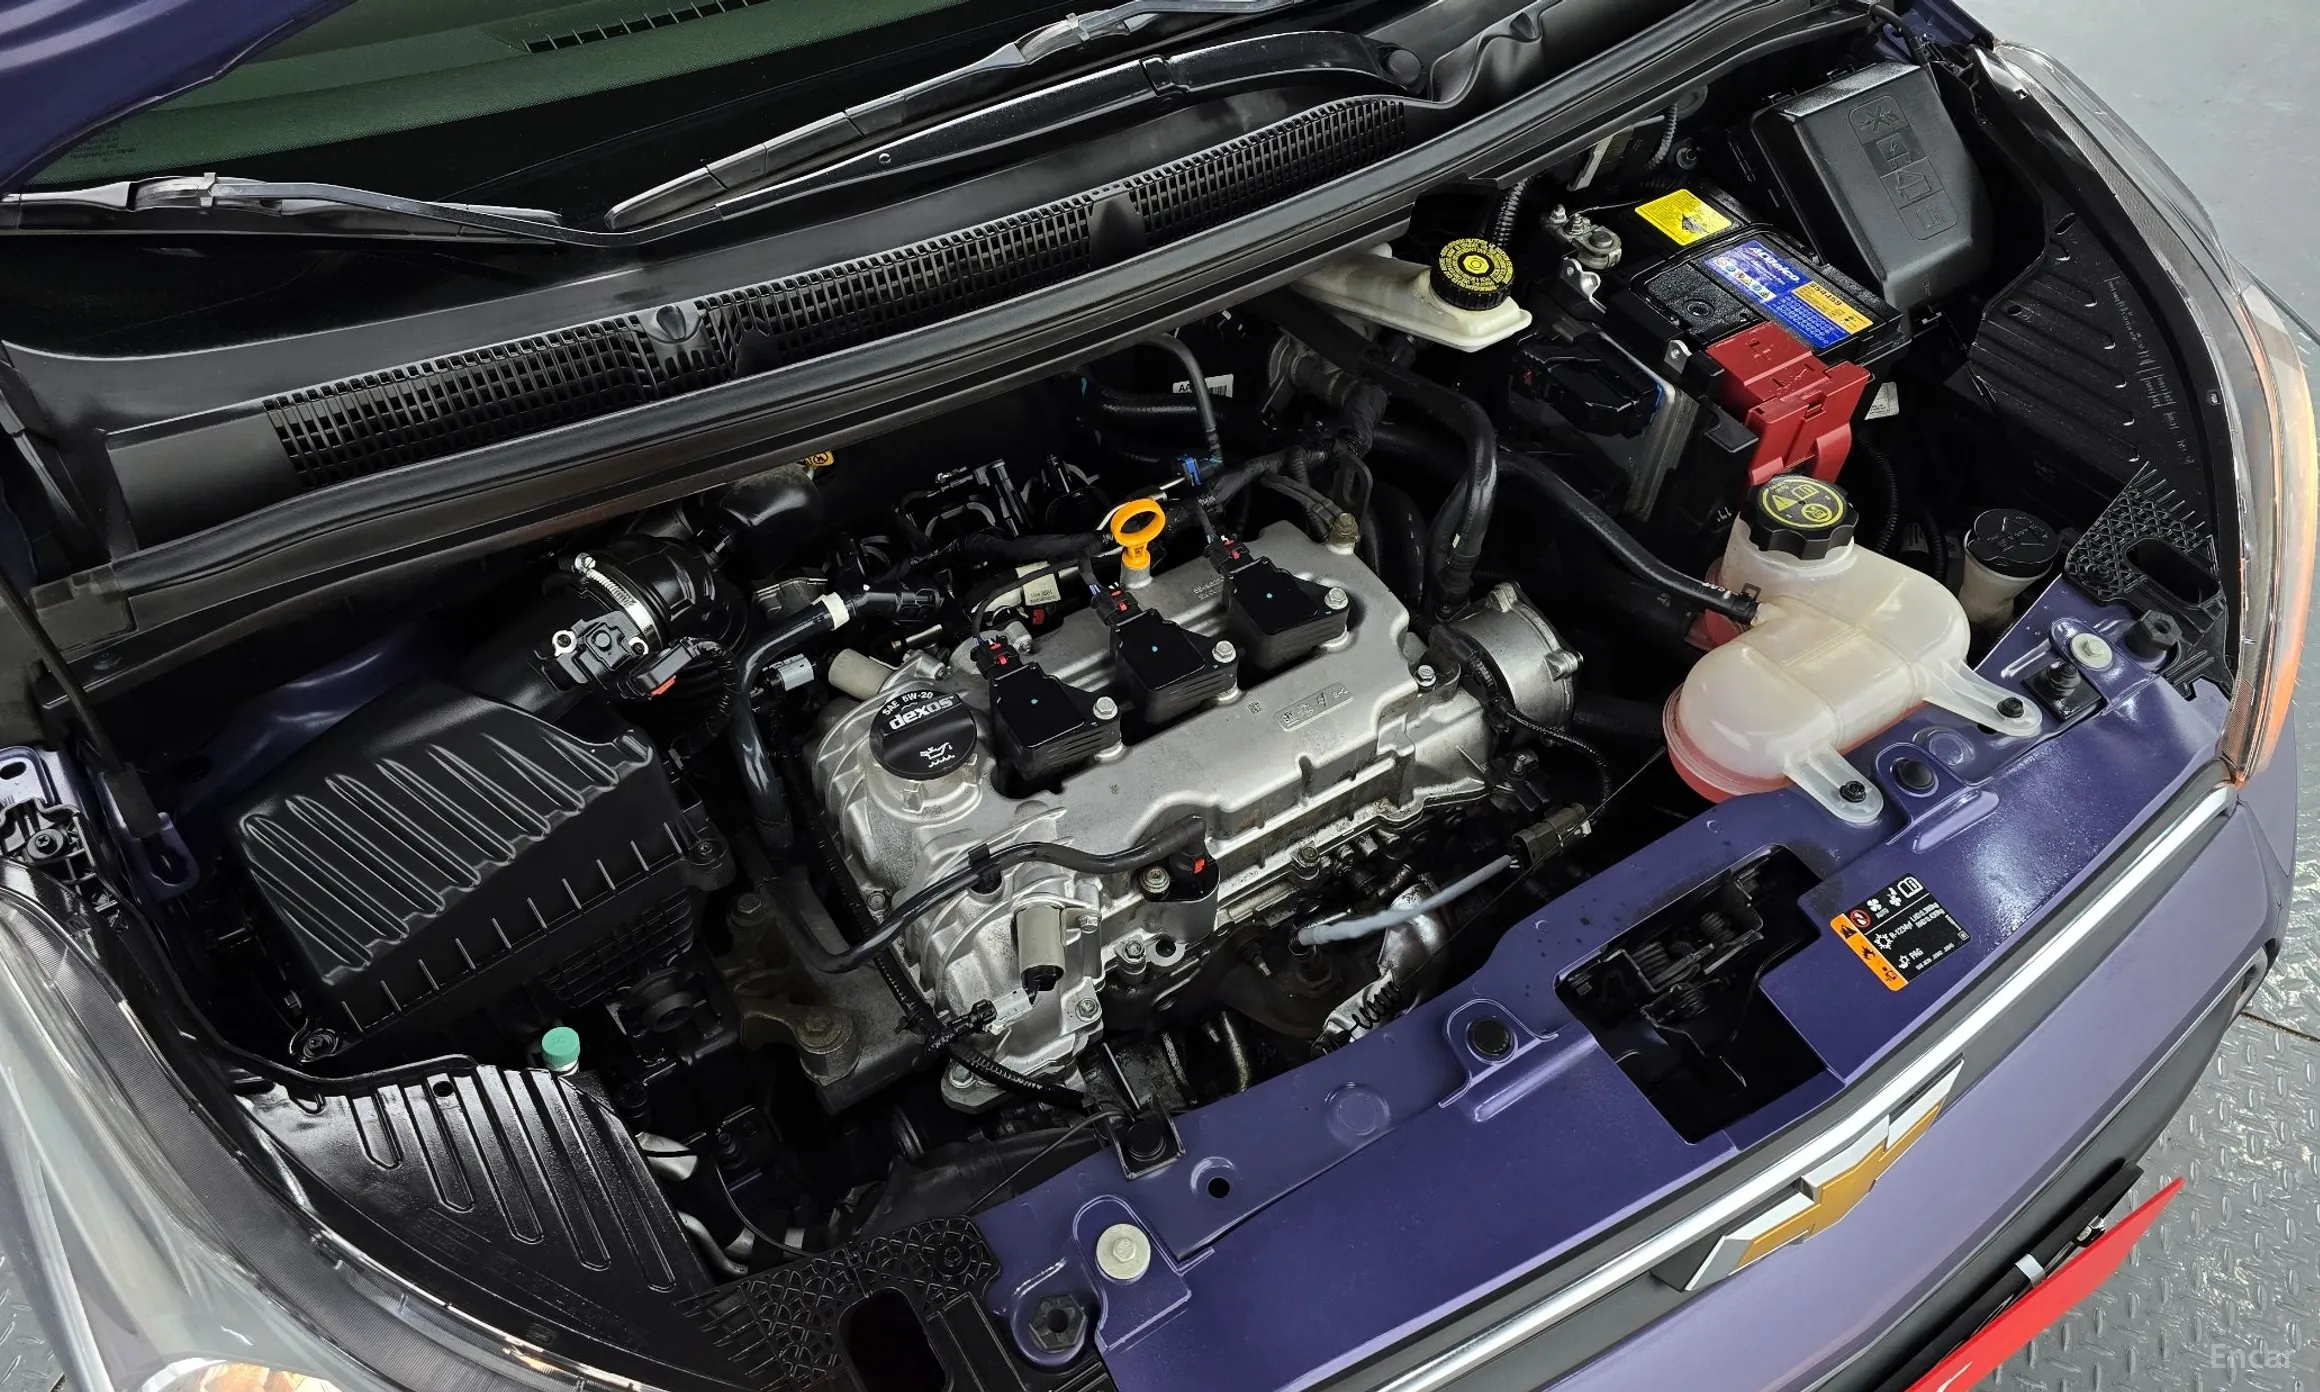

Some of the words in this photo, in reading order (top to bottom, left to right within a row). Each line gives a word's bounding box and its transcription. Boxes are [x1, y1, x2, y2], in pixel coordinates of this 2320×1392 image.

[882, 700, 899, 716] SAE
[902, 691, 934, 704] 5W-20
[1909, 948, 1925, 961] PAG
